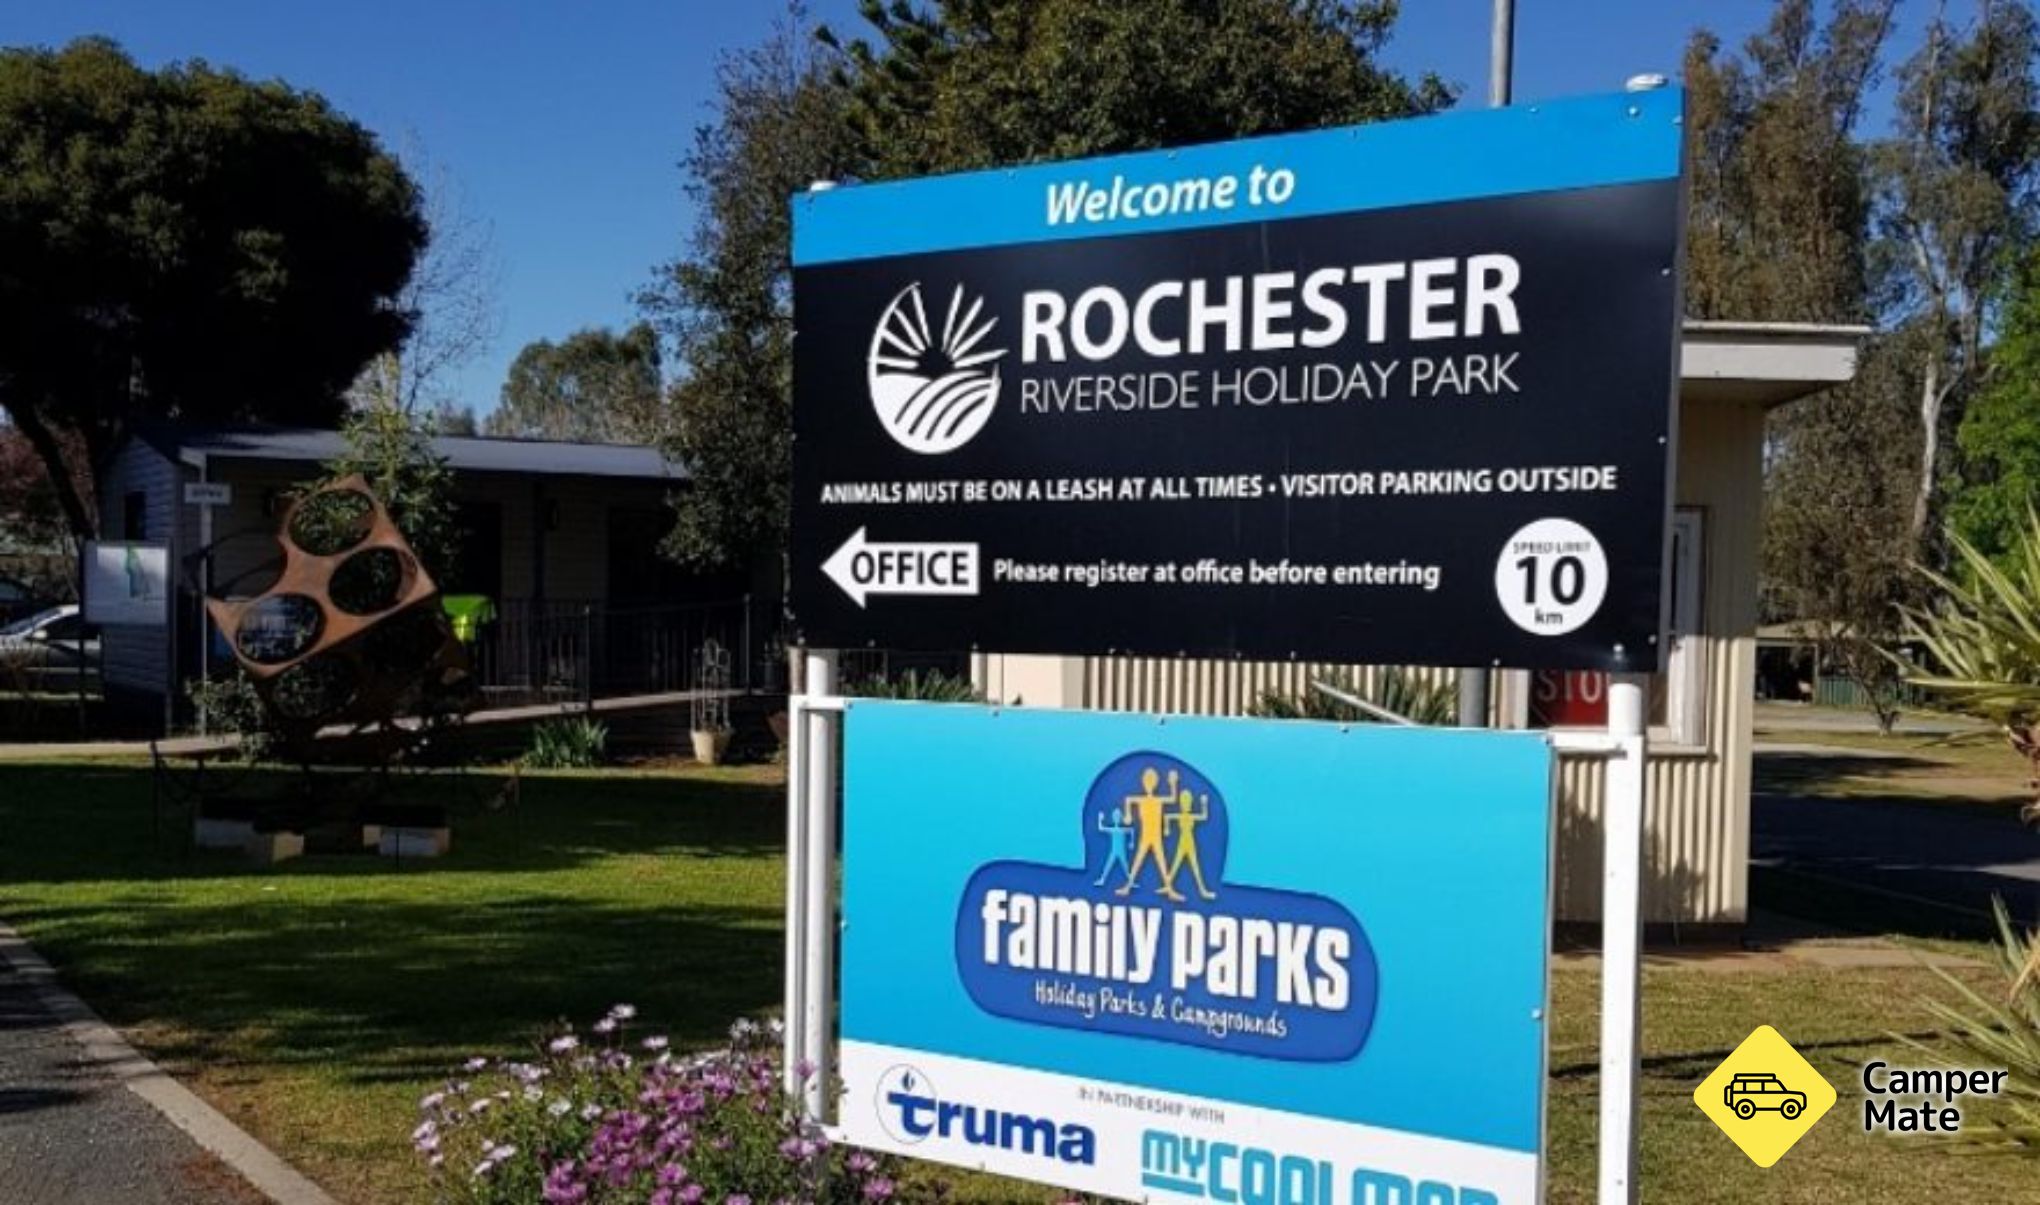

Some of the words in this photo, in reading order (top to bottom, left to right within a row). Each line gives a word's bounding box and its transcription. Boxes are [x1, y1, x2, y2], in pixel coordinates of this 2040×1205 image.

[1047, 175, 1238, 226] Welcome
[1249, 165, 1296, 205] to
[1021, 253, 1521, 363] ROCHESTER
[1020, 371, 1200, 414] RIVERSIDE
[1211, 360, 1400, 407] HOLIDAY
[1410, 352, 1520, 397] PARK
[821, 482, 902, 503] ANIMALS
[905, 481, 960, 503] MUST
[963, 480, 988, 502] BE
[991, 479, 1022, 501] ON
[1026, 479, 1041, 500] A
[1046, 478, 1113, 501] LEASH
[1117, 477, 1146, 500] AT
[1149, 477, 1191, 499] ALL
[1195, 474, 1263, 498] TIMES
[1281, 472, 1373, 497] VISITOR
[1380, 469, 1492, 495] PARKING
[1497, 465, 1618, 492] OUTSIDE
[851, 550, 969, 586] OFFICE
[994, 558, 1060, 583] Please
[1064, 559, 1150, 588] register
[1153, 562, 1177, 582] at
[1181, 557, 1244, 583] office
[1249, 558, 1328, 584] before
[1332, 559, 1442, 590] entering
[1515, 555, 1586, 606] 10
[1534, 609, 1564, 625] km
[1536, 669, 1610, 703] STO
[982, 888, 1163, 984] family
[1034, 979, 1096, 1019] Holiday
[1100, 987, 1147, 1018] Parks
[1150, 993, 1167, 1019] &
[1170, 995, 1288, 1038] Campgrounds
[886, 1089, 1096, 1167] truma
[1098, 1090, 1184, 1118] PARTNERSHIP
[1190, 1103, 1226, 1125] WITH
